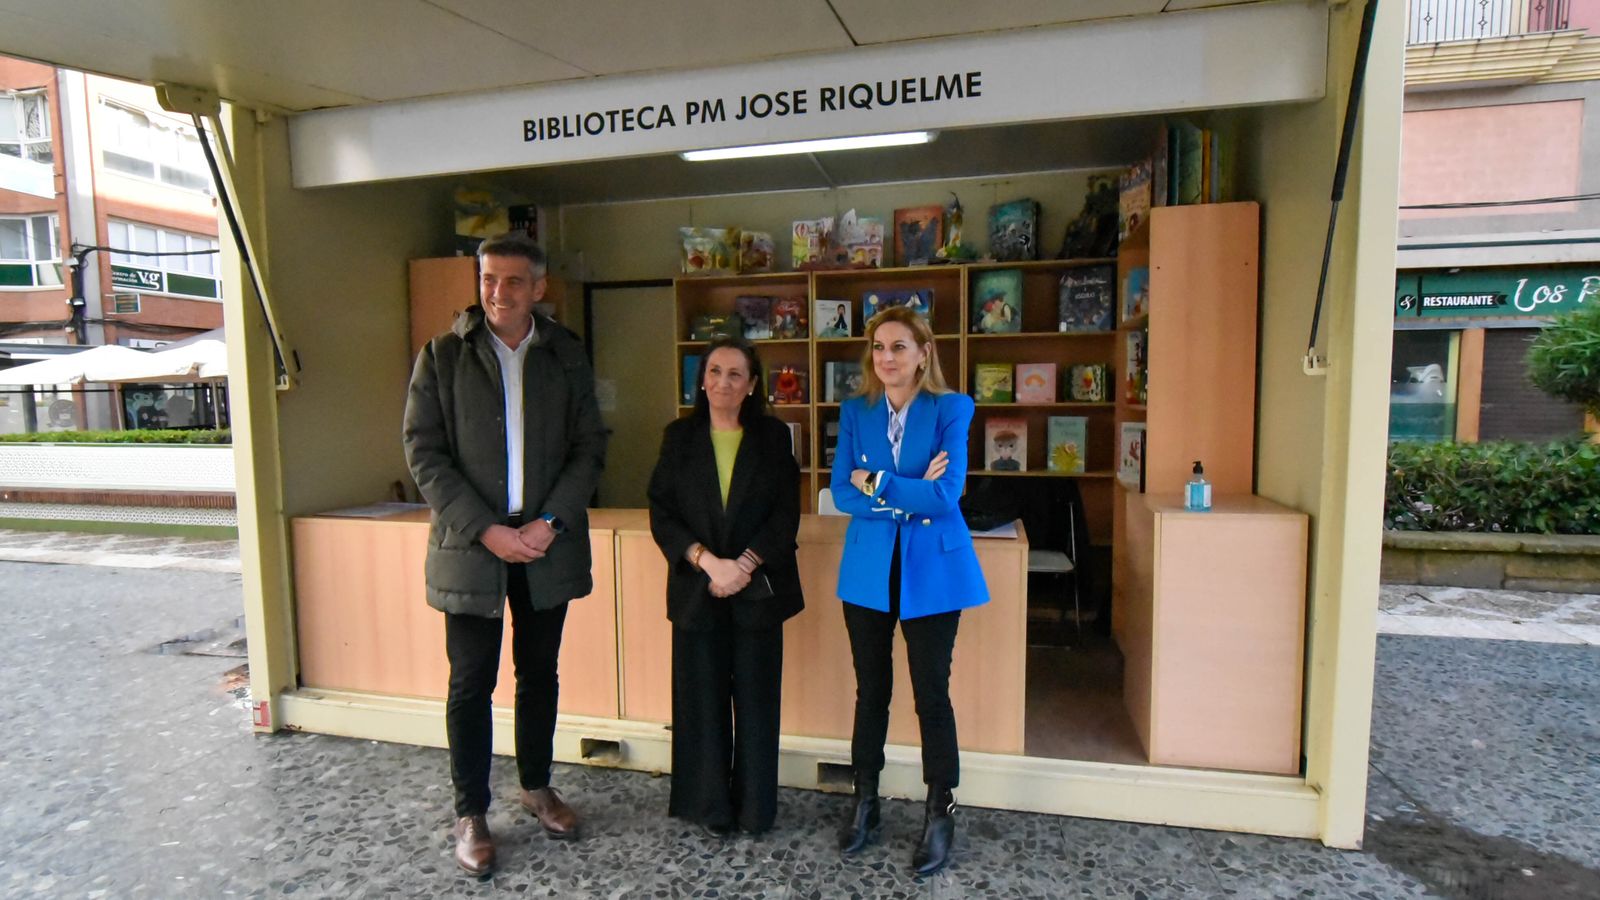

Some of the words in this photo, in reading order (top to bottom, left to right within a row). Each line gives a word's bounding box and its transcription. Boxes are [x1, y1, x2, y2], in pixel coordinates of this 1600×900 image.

[524, 105, 675, 141] BIBLIOTECA
[687, 98, 725, 125] PM
[736, 90, 806, 120] JOSE
[821, 72, 981, 112] RIQUELME
[1423, 294, 1493, 307] RESTAURANTE
[1513, 278, 1568, 312] Los
